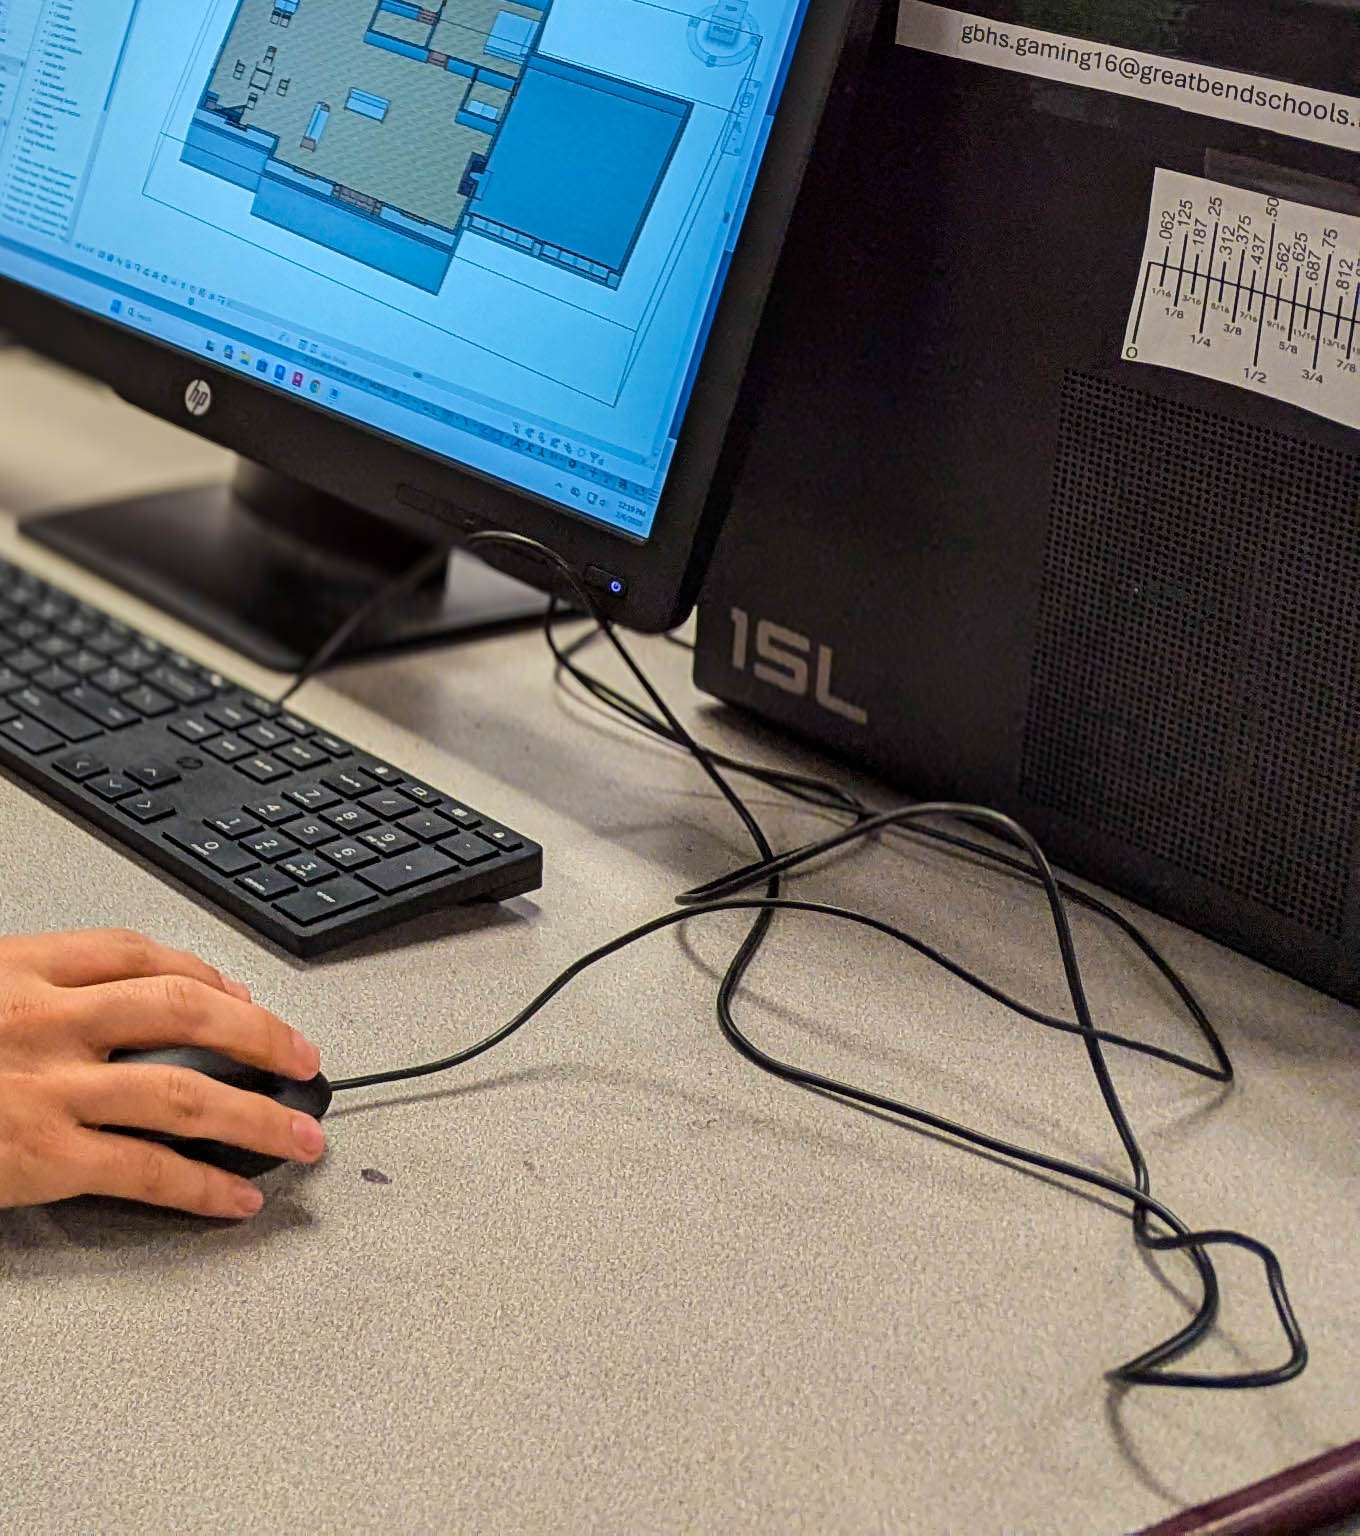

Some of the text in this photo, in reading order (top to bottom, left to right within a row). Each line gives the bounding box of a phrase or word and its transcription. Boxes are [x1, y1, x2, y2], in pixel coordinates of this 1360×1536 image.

[960, 24, 1360, 129] gbhs.gaming16@greatbendschools.
[1208, 196, 1223, 222] .25
[1266, 197, 1280, 222] .50
[1159, 210, 1176, 245] .062
[1192, 217, 1208, 253] .187
[1235, 215, 1252, 250] .375
[1219, 224, 1236, 261] .312
[1250, 233, 1267, 270] .437
[1291, 232, 1308, 267] .625
[1322, 228, 1338, 254] .75
[1275, 242, 1291, 278] .562
[1305, 250, 1322, 286] .687
[1336, 259, 1353, 295] .812
[1152, 287, 1172, 298] 1/16
[1164, 306, 1184, 320] 1/8
[1190, 334, 1212, 348] 1/4
[1223, 323, 1242, 336] 3/8
[1243, 368, 1268, 384] 1/2
[1301, 369, 1324, 385] 3/4
[1336, 358, 1356, 373] 7/8
[342, 811, 357, 820] 8
[303, 825, 319, 835] 5
[380, 833, 396, 842] 9
[341, 848, 356, 856] 6
